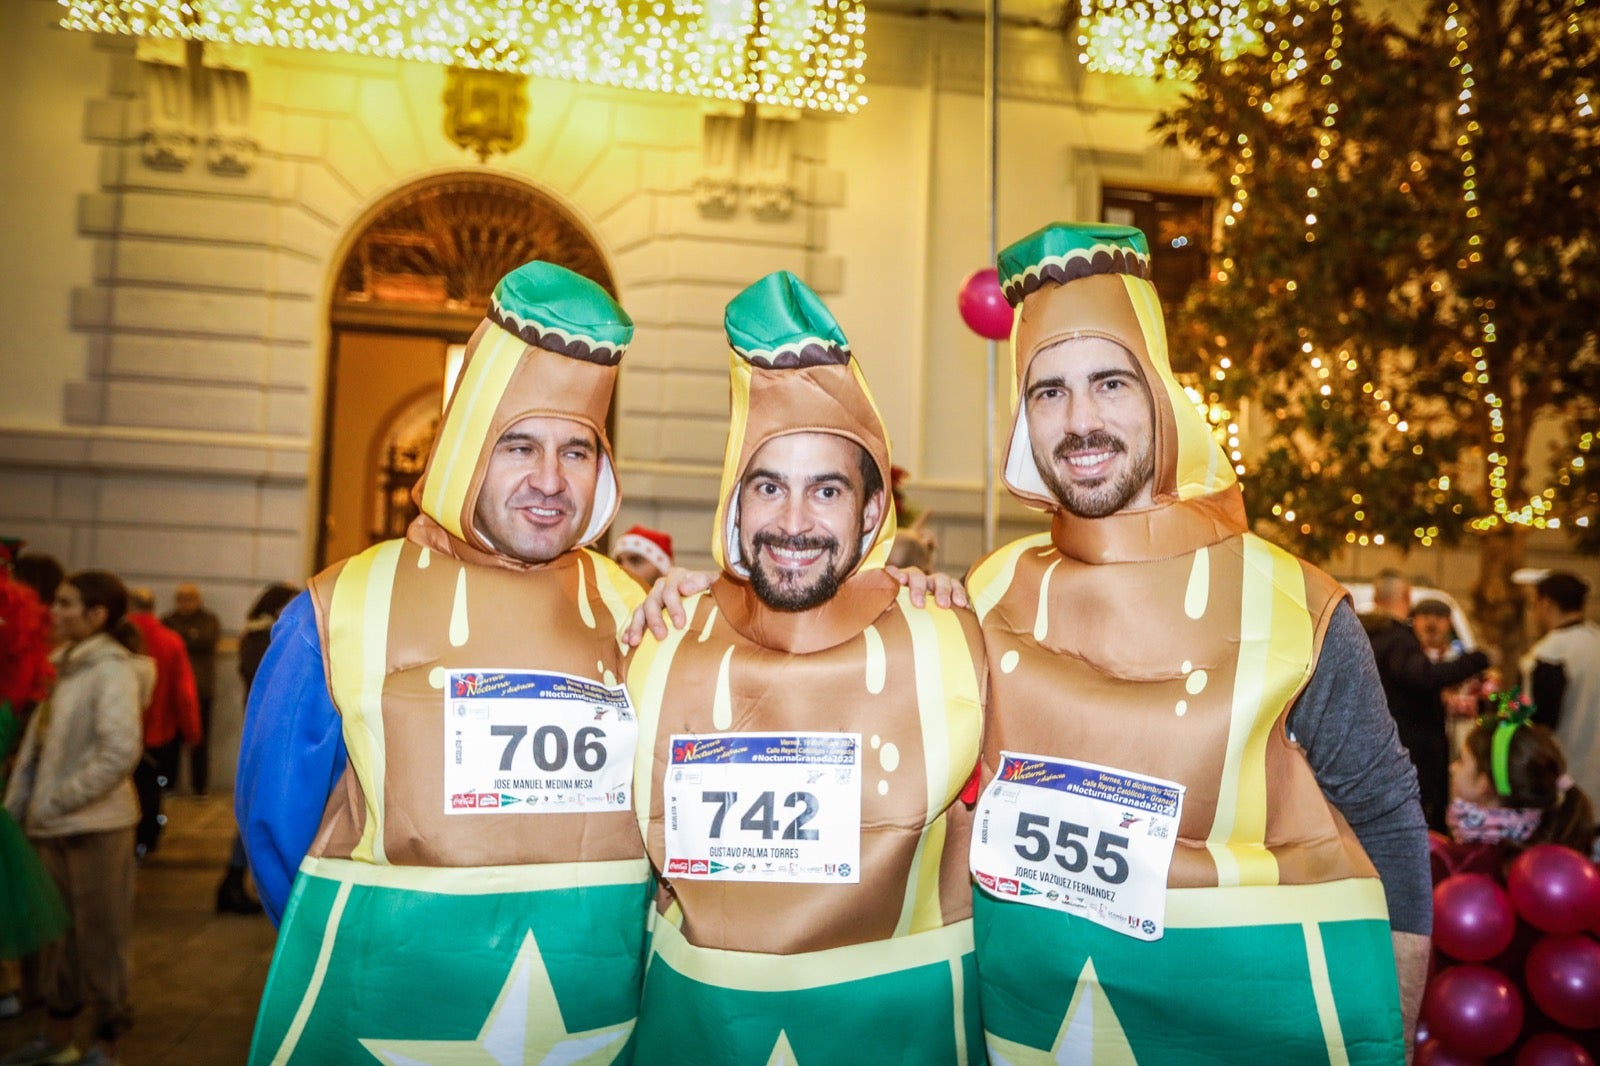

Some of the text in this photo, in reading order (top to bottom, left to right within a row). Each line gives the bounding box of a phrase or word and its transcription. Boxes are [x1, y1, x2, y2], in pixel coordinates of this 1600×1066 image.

[466, 680, 511, 697] Nocturna
[490, 725, 607, 772] 706
[493, 779, 593, 789] JOSE MANUEL MEDINA MESA
[1082, 779, 1097, 787] Calle
[1097, 781, 1115, 792] Reyes
[1099, 773, 1122, 786] Viernes,
[1132, 782, 1162, 794] diciembre
[1066, 784, 1176, 816] #NocturnaGranada2022
[702, 791, 819, 840] 742
[709, 847, 799, 858] GUSTAVO PALMA TORRES
[1014, 811, 1129, 884] 555
[1014, 866, 1038, 880] JORGE
[1040, 871, 1072, 889] VAZQUEZ
[1073, 881, 1116, 902] FERNANDEZ
